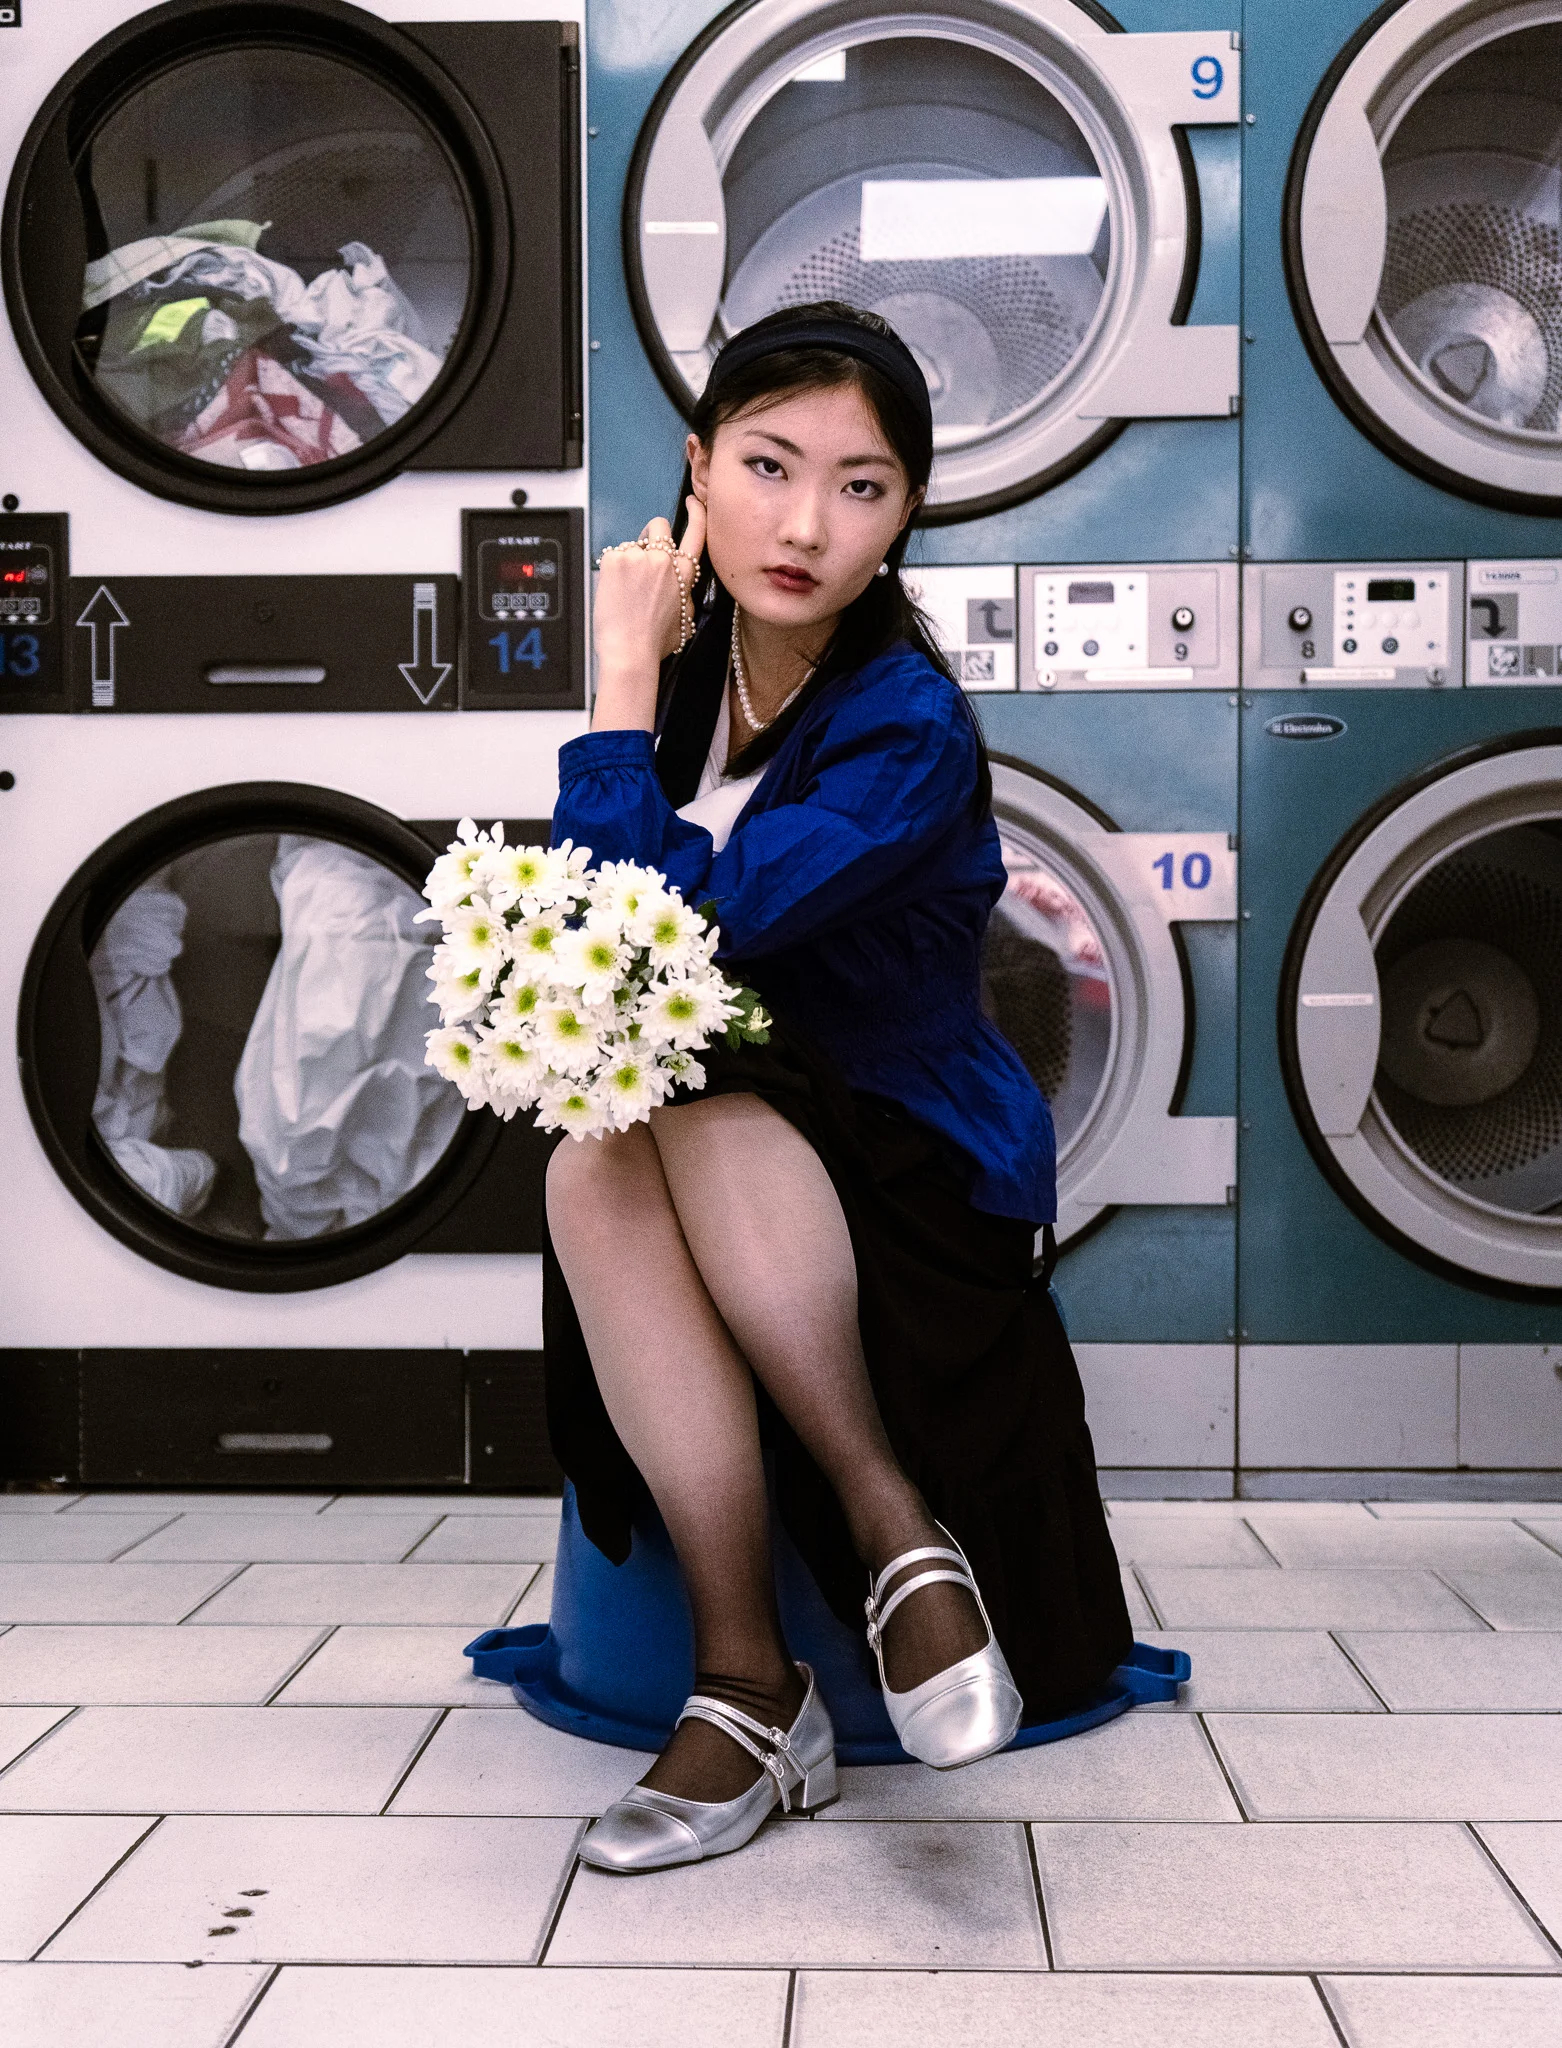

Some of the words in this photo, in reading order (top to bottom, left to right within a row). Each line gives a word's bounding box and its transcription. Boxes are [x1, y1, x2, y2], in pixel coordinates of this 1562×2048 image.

[1191, 55, 1223, 99] 9
[498, 537, 541, 545] START
[488, 627, 547, 673] 14
[1174, 643, 1189, 661] 9
[1301, 640, 1315, 659] 8
[1283, 722, 1333, 733] Electrolux
[1152, 852, 1212, 890] 10
